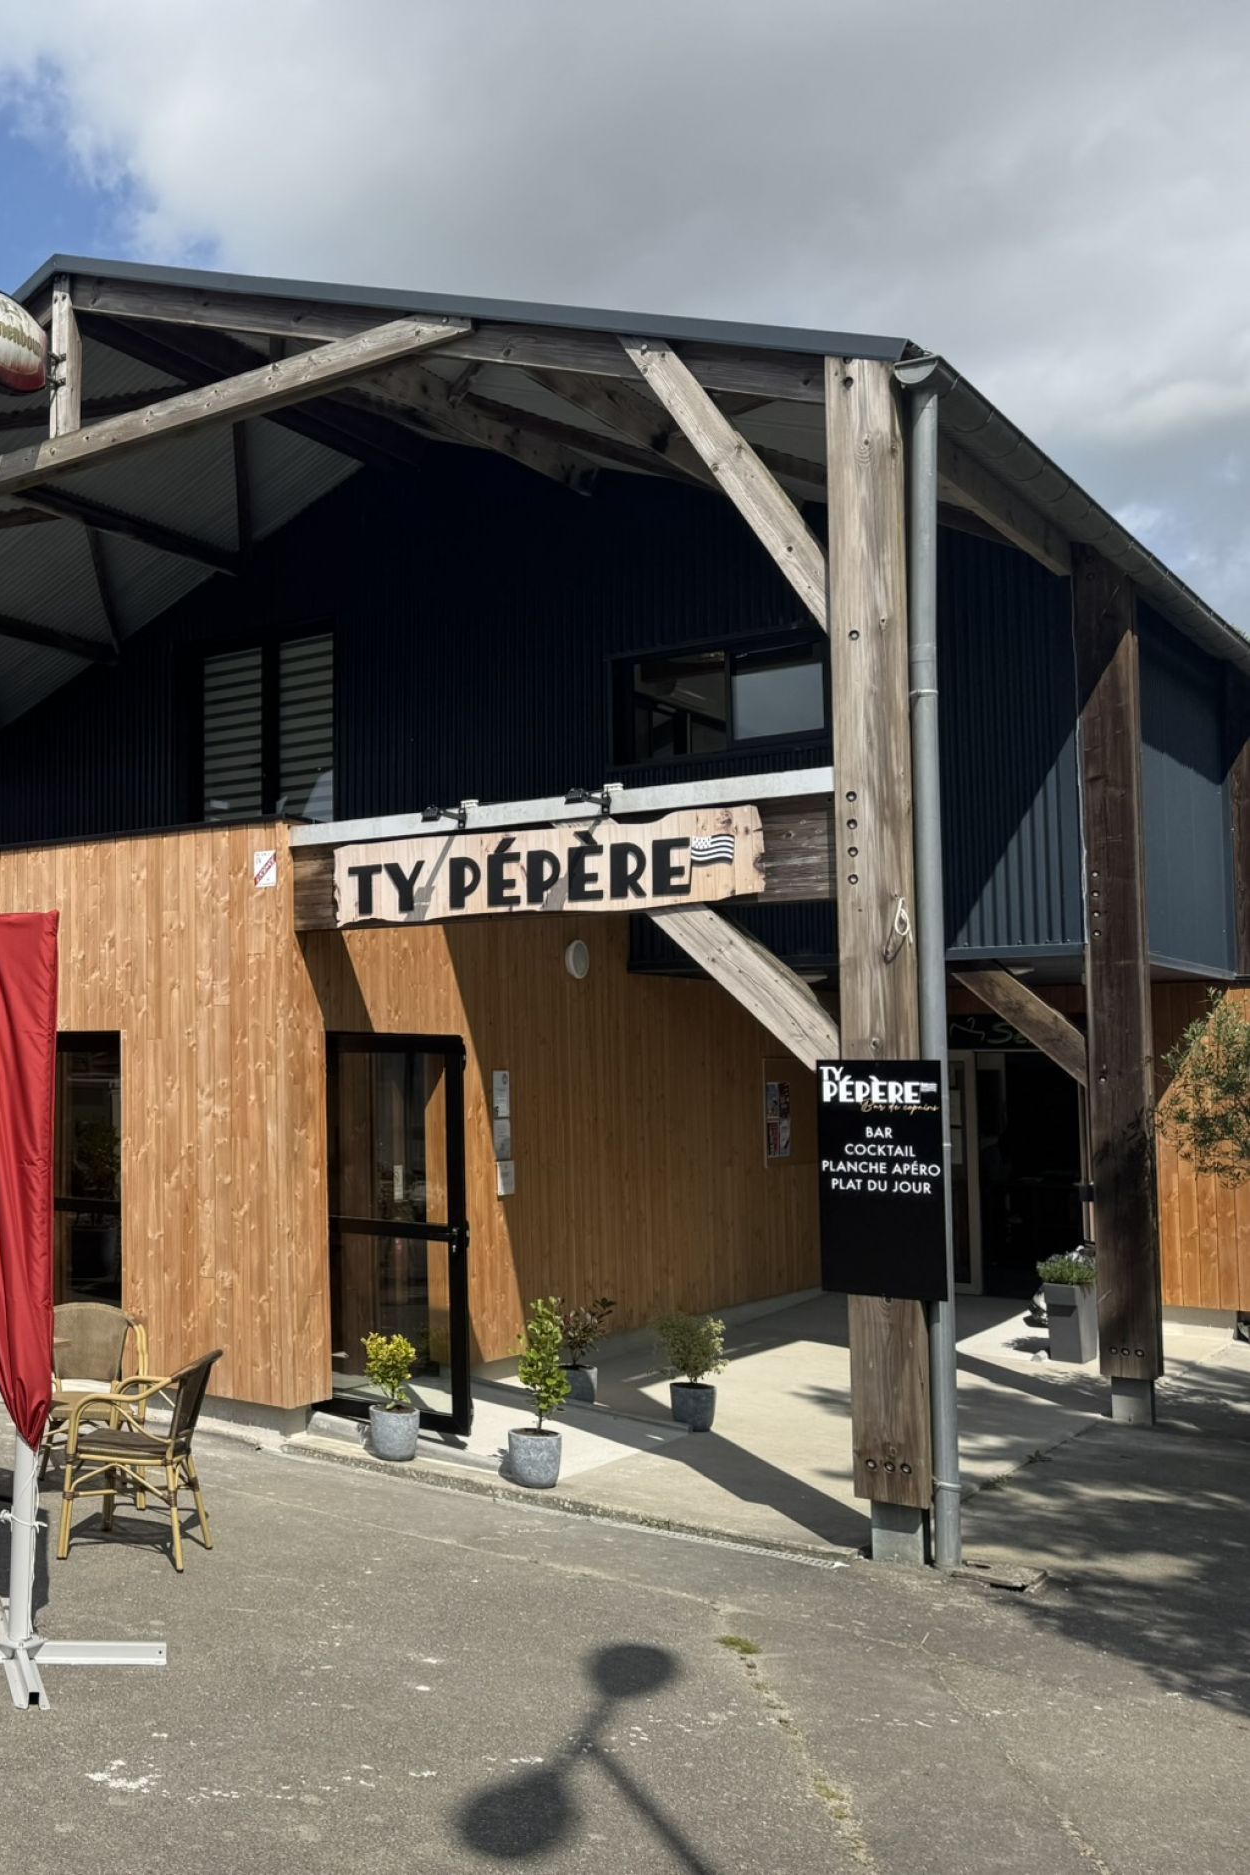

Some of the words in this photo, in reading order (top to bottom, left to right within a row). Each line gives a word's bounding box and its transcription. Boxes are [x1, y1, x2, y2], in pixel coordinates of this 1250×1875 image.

[348, 859, 425, 915] TY
[448, 829, 692, 908] PÉPÈRE
[819, 1066, 844, 1081] TY
[822, 1075, 921, 1104] PÉPÈRE
[865, 1126, 893, 1139] BAR
[844, 1143, 916, 1157] COCKTAIL
[821, 1160, 887, 1174] PLANCHE
[891, 1160, 941, 1177] APÉRO
[831, 1177, 863, 1190] PLAT
[867, 1179, 888, 1192] DU
[892, 1181, 932, 1194] JOUR
